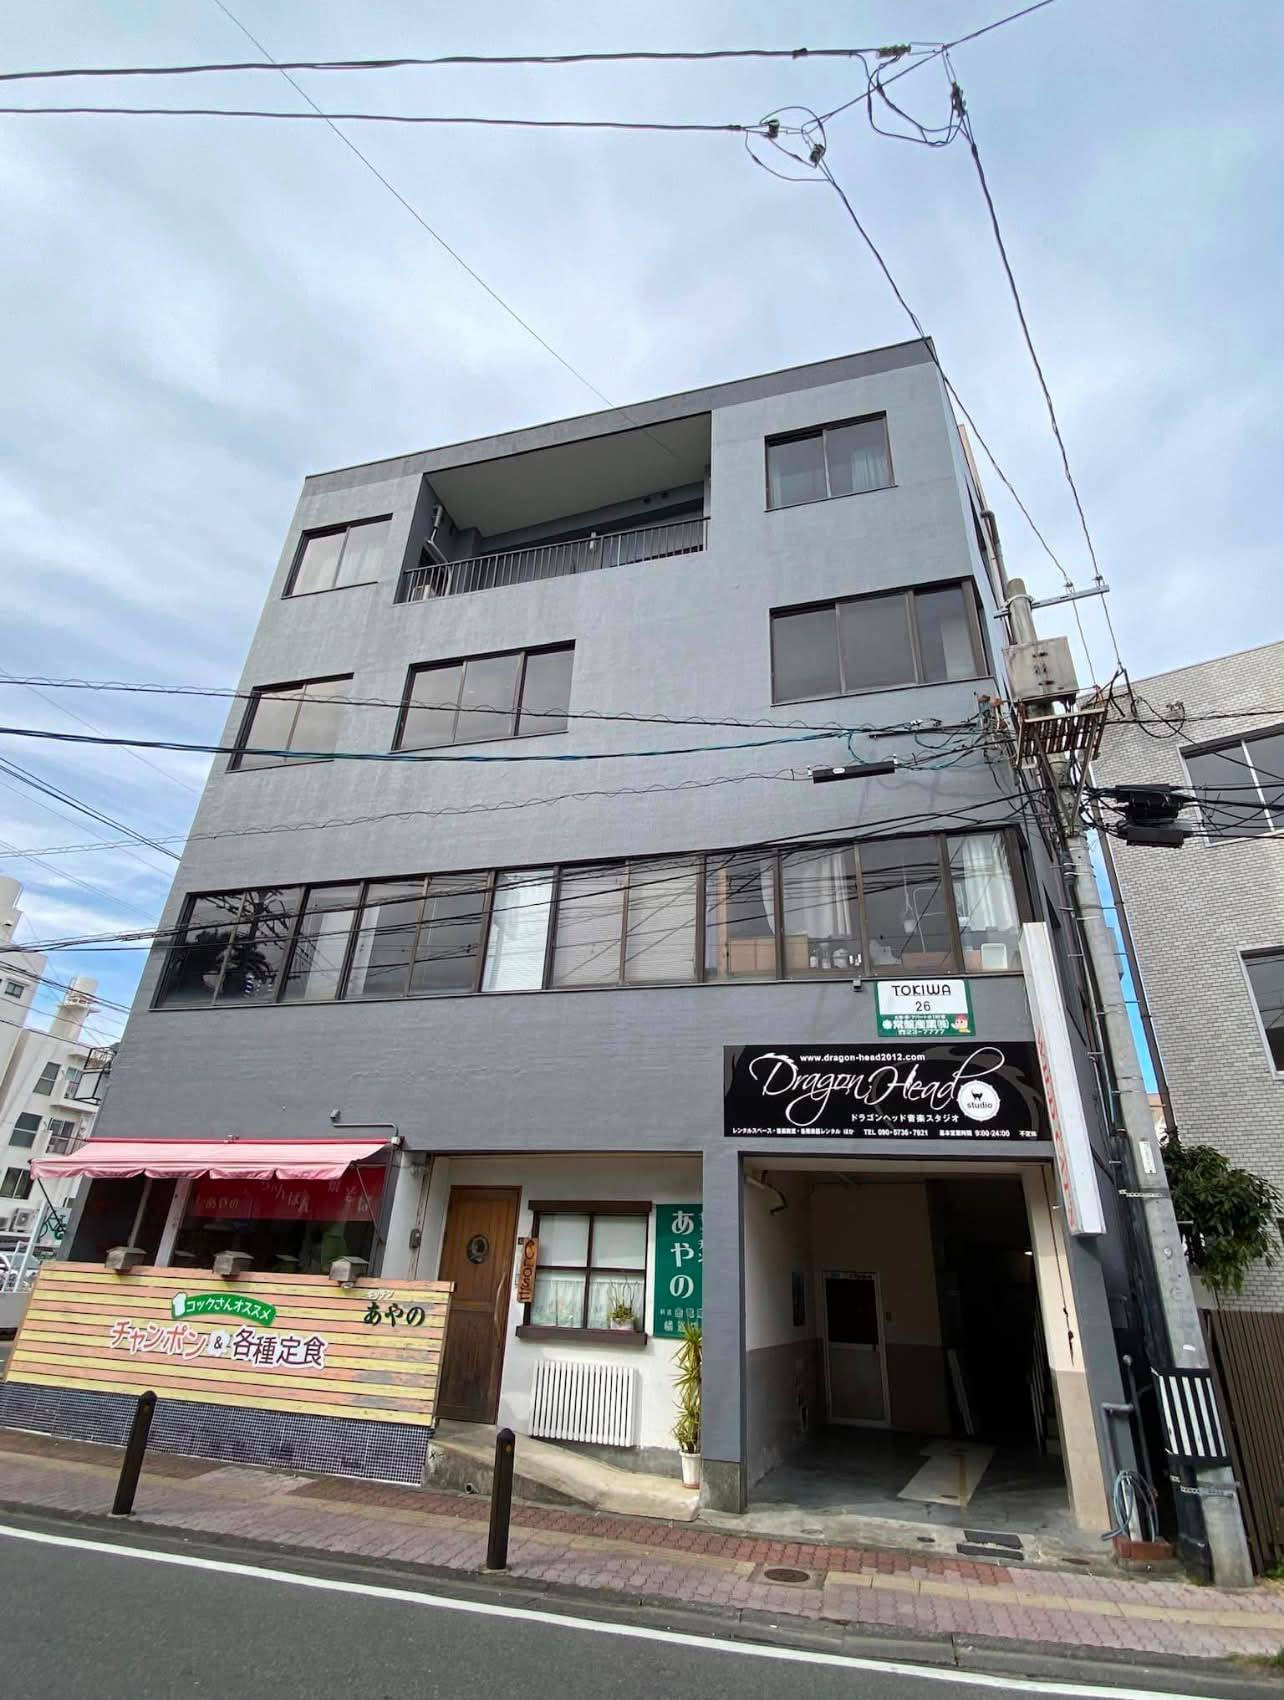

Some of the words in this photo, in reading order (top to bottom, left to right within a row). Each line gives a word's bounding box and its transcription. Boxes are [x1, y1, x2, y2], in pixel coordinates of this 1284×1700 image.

[891, 984, 951, 997] TOKIWA
[915, 1001, 931, 1012] 26
[800, 1052, 926, 1063] www.dragon-head2012.com
[749, 1052, 873, 1127] Dragon
[864, 1047, 1005, 1111] Head
[967, 1101, 993, 1109] studio
[851, 1113, 960, 1123] ドラゴンヘッド音楽スタジオ
[863, 1128, 876, 1136] TEL
[670, 1210, 695, 1299] あやの
[186, 1297, 273, 1320] コックさんオススメ
[364, 1302, 426, 1327] あやの
[110, 1320, 209, 1360] チャンポン
[214, 1335, 224, 1350] &
[233, 1326, 326, 1367] 各種定食
